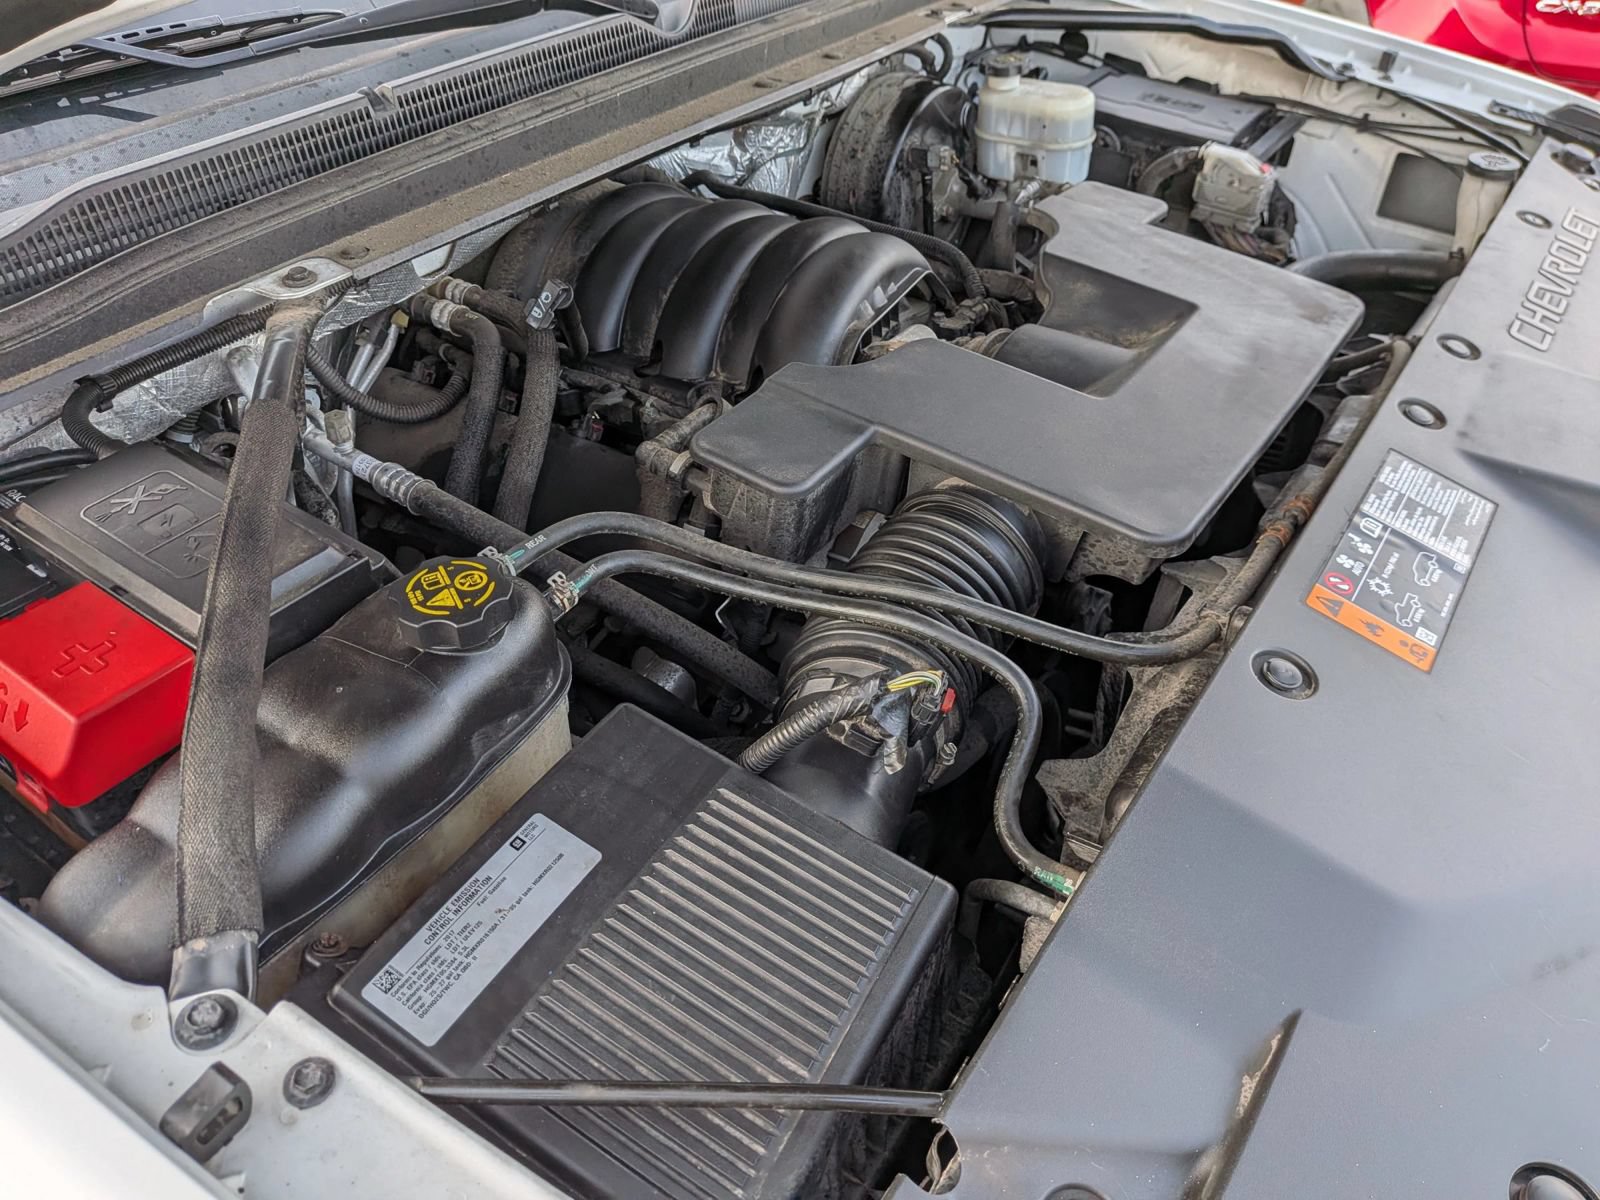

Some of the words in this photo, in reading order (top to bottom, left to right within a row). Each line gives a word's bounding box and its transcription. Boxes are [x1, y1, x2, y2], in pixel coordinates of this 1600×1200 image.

[1508, 206, 1600, 352] CHEVROLET
[524, 534, 547, 550] REAR
[425, 905, 453, 932] VEHICLE
[449, 876, 481, 907] EMISSION
[486, 875, 507, 895] Gasoline
[423, 914, 454, 945] CONTROL
[451, 874, 493, 916] INFORMATION
[442, 929, 455, 942] 2017
